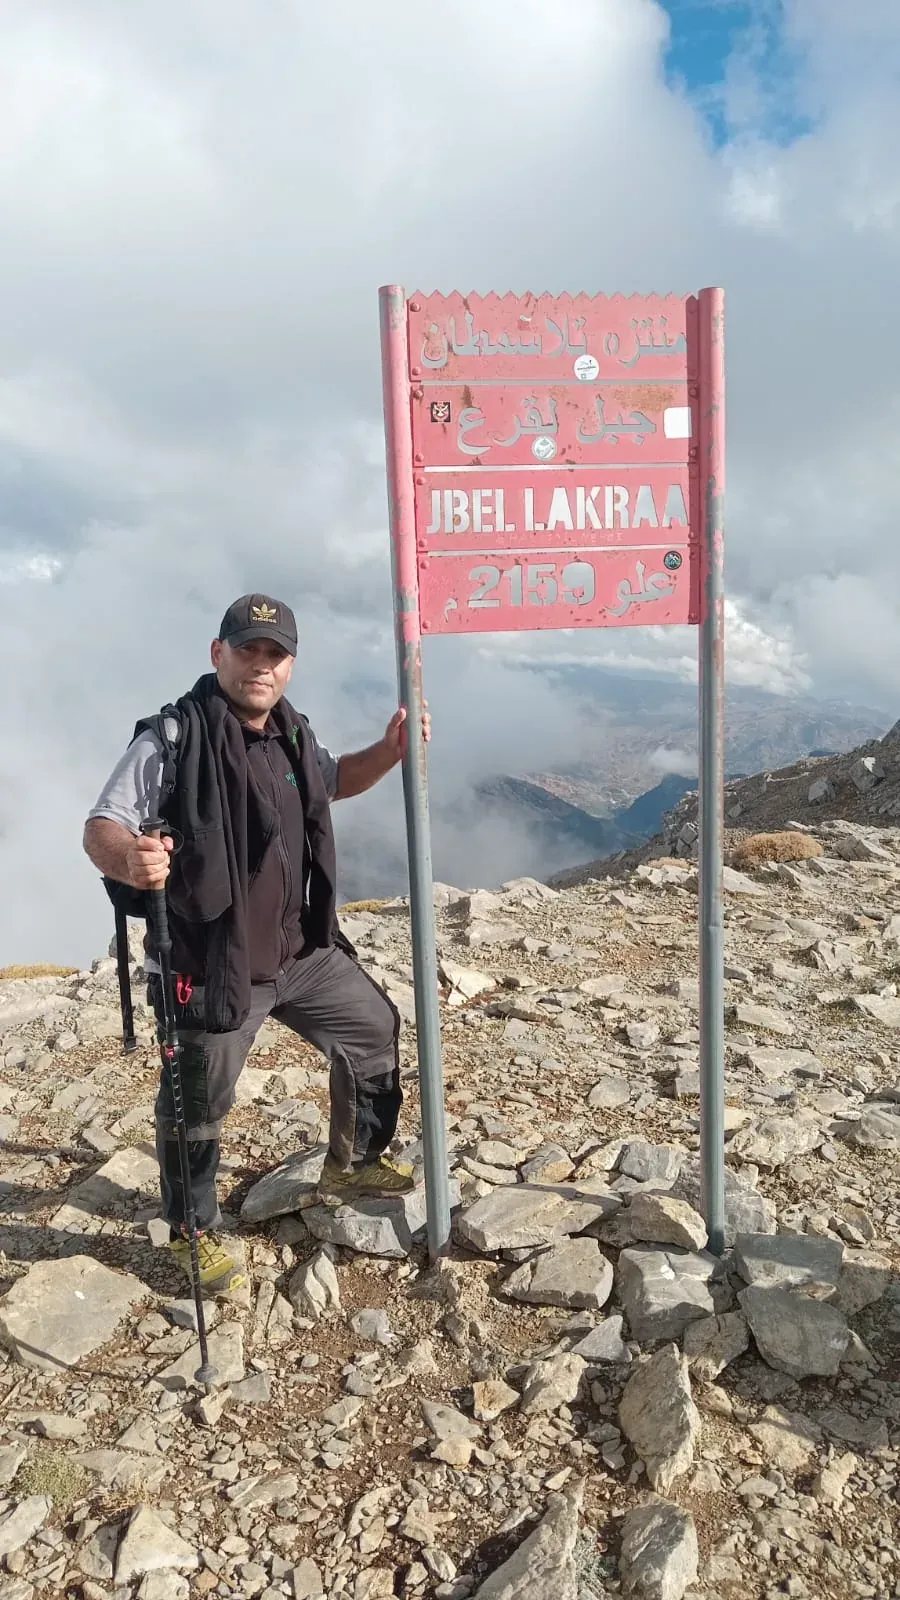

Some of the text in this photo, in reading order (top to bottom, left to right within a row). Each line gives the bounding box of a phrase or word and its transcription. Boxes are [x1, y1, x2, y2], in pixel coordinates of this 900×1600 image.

[603, 315, 687, 368] منتزه
[576, 394, 657, 446] جبل
[426, 484, 689, 535] JBEL LAKRAA
[467, 560, 596, 609] 2159
[603, 559, 676, 616] علو
